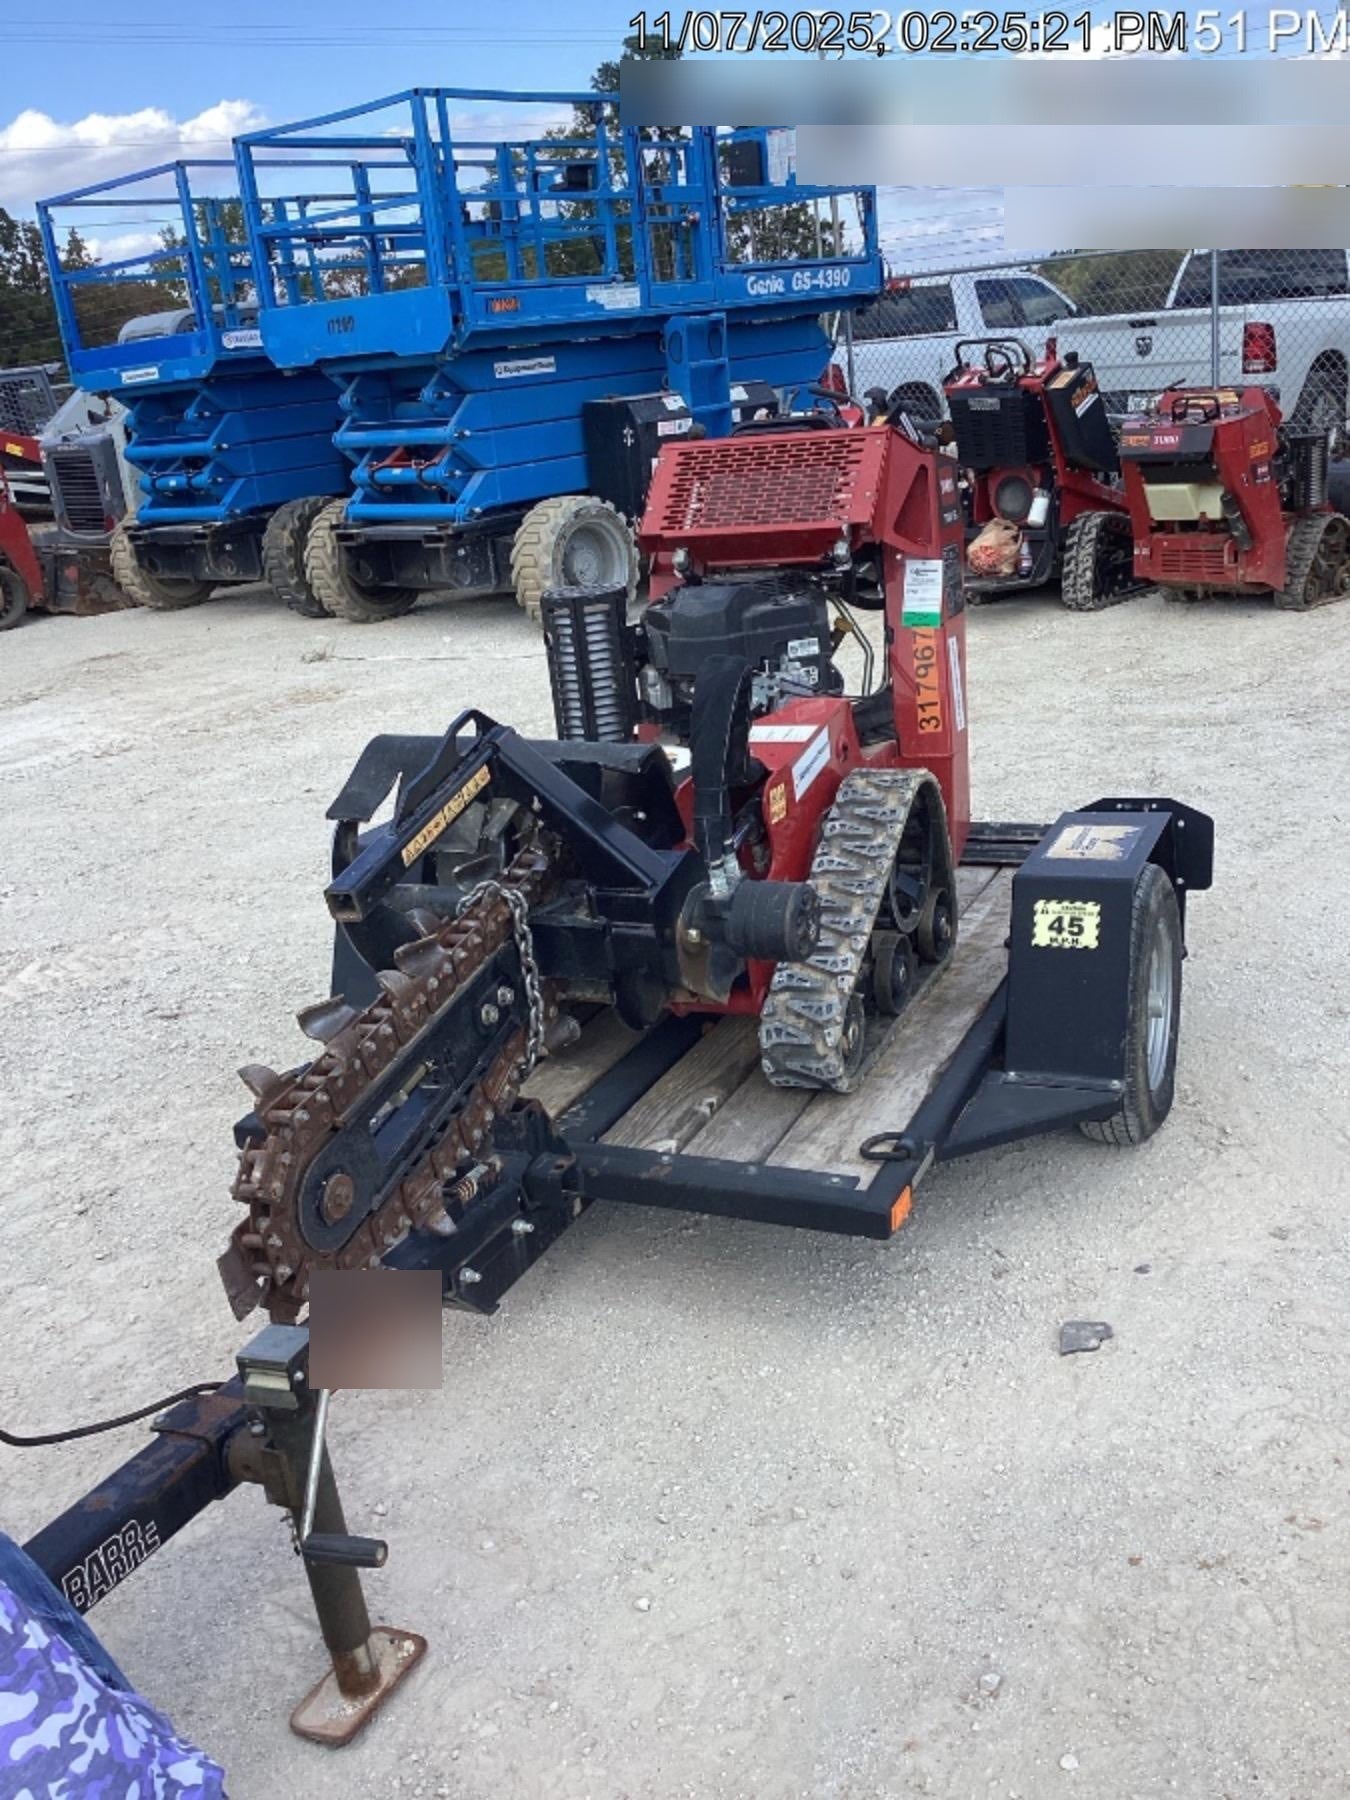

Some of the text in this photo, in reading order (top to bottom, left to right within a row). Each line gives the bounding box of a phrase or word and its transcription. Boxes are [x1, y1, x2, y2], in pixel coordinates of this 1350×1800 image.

[747, 268, 850, 296] Genie GS-4390
[912, 630, 940, 730] 317967
[1047, 915, 1084, 936] 45
